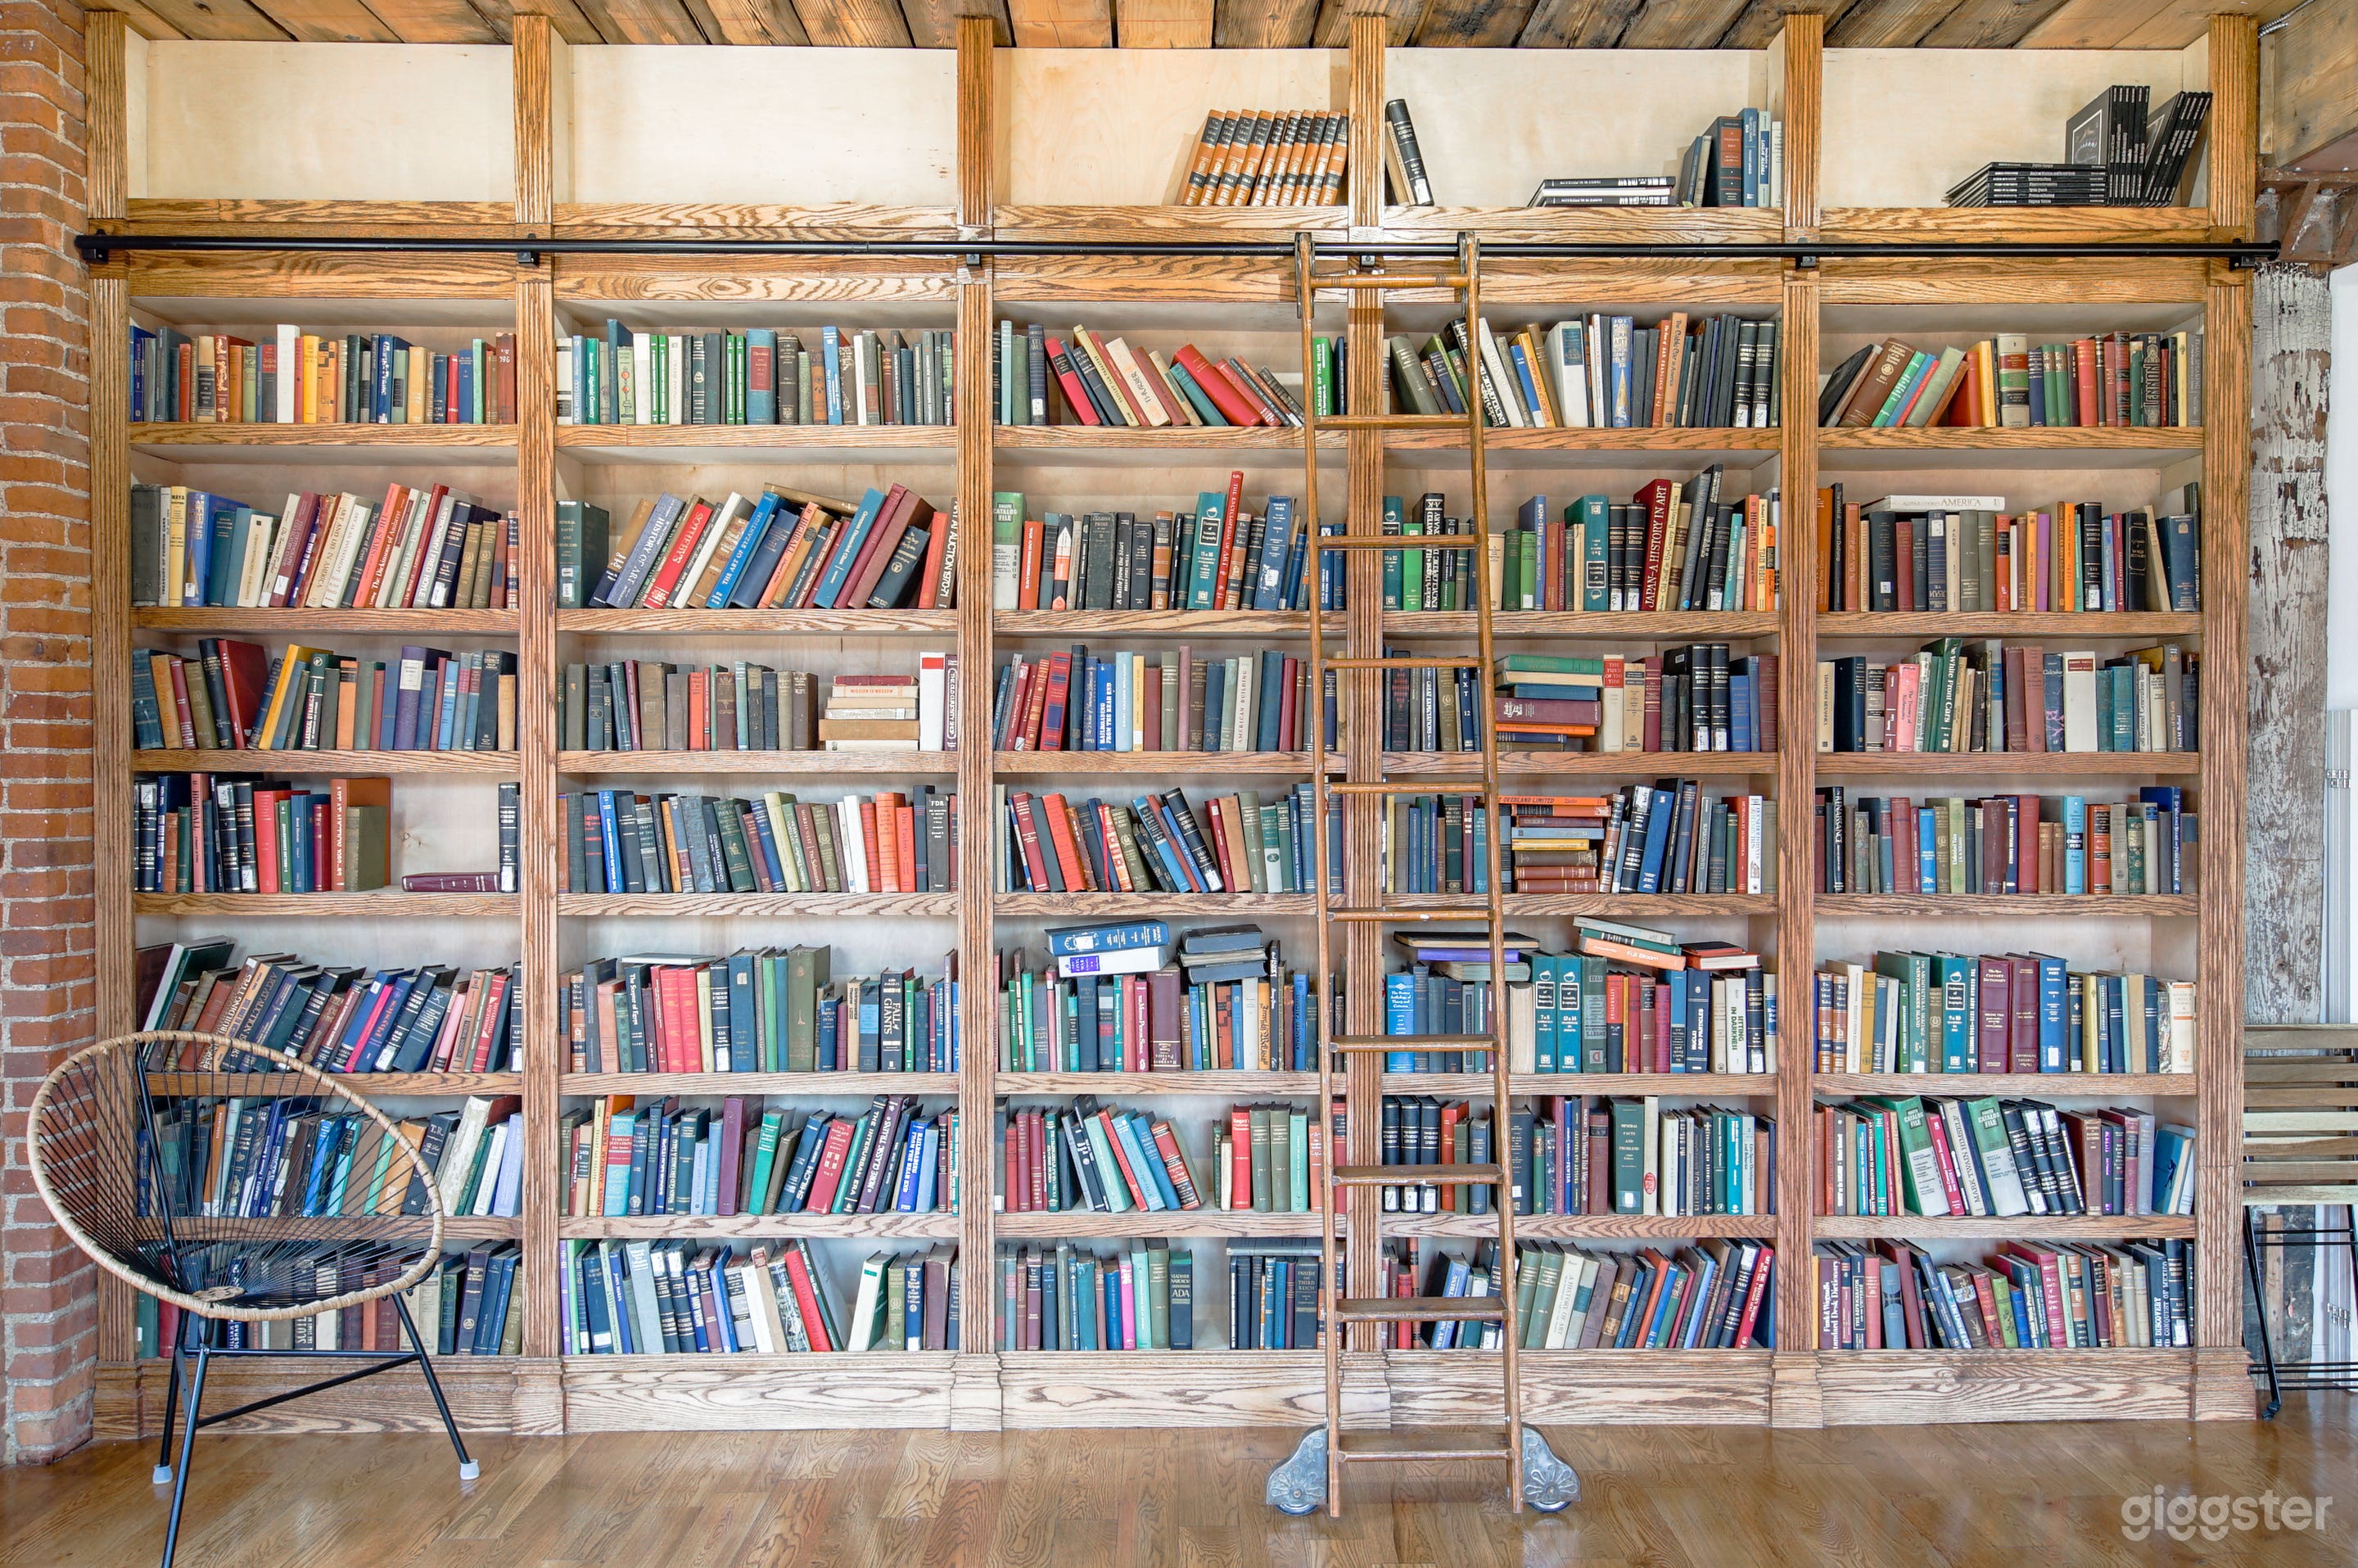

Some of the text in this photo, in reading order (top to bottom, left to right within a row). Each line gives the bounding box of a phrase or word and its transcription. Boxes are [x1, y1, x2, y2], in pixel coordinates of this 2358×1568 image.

[1670, 350, 1678, 361] Car
[1671, 329, 1680, 350] Cable
[1659, 360, 1667, 390] FRANCISCO
[2143, 362, 2160, 408] LENNON
[1656, 486, 1667, 506] ART
[1940, 498, 1981, 506] AMERICA
[364, 520, 376, 539] Scepter
[951, 519, 958, 531] AT
[1225, 497, 1237, 540] ENCYCLOPEDIA
[1654, 507, 1663, 519] IN
[373, 545, 390, 577] Dickinsons
[387, 510, 401, 535] Amherst
[671, 511, 704, 564] SOTHEBY'S
[724, 512, 763, 585] THE ART OF BYZANTIUM
[784, 517, 809, 554] HIGHBALL
[1225, 542, 1230, 550] OF
[1647, 521, 1662, 563] HISTORY
[1749, 512, 1759, 552] HIGHBALL
[359, 545, 368, 562] Egypt
[418, 506, 450, 599] ASTRONOMY FRED HOYLE
[627, 517, 665, 585] HISTORY OF ART
[945, 531, 958, 570] AUCTION
[1222, 551, 1231, 567] ART
[940, 571, 951, 598] 1970-71
[1947, 655, 1957, 676] White
[1240, 670, 1248, 703] BUILDING
[1945, 680, 1955, 701] Front
[305, 694, 314, 745] CLASSICAL DYNAMICS
[1944, 701, 1954, 722] Cars
[192, 791, 201, 830] HIGHBALL
[1834, 796, 1842, 843] RENAISSANCE
[1700, 824, 1708, 870] SUPERCONDUCTIVITY
[1638, 952, 1659, 961] Bloom
[221, 974, 252, 1033] BUILDING TYPES
[244, 973, 278, 1033] ART AT AUCTION
[375, 1001, 398, 1037] Physics
[630, 1010, 639, 1025] Egypt
[883, 997, 892, 1035] GIANTS
[892, 1002, 901, 1023] FALL
[1904, 1112, 1924, 1123] CATALOG
[1909, 1118, 1922, 1128] FILE
[850, 1110, 879, 1195] THE INTERURBAN ERA
[868, 1120, 891, 1188] MORE CLASSIC TRAINS
[911, 1132, 923, 1174] RAILROADING
[1952, 1115, 1981, 1204] MARK TWAIN HIMSELF
[797, 1166, 814, 1200] SHILOH
[1172, 1289, 1190, 1298] ADA
[1564, 1281, 1574, 1308] HISTORY
[1753, 1282, 1765, 1307] WESTERN
[1831, 1259, 1841, 1349] tandard Desk Dictionary
[2162, 1290, 2170, 1299] OF
[1557, 1320, 1565, 1335] ART
[1561, 1310, 1567, 1318] OF
[1749, 1307, 1759, 1322] WORLD
[2153, 1297, 2162, 1336] DISCOVERY
[2162, 1301, 2171, 1336] CONQUEST
